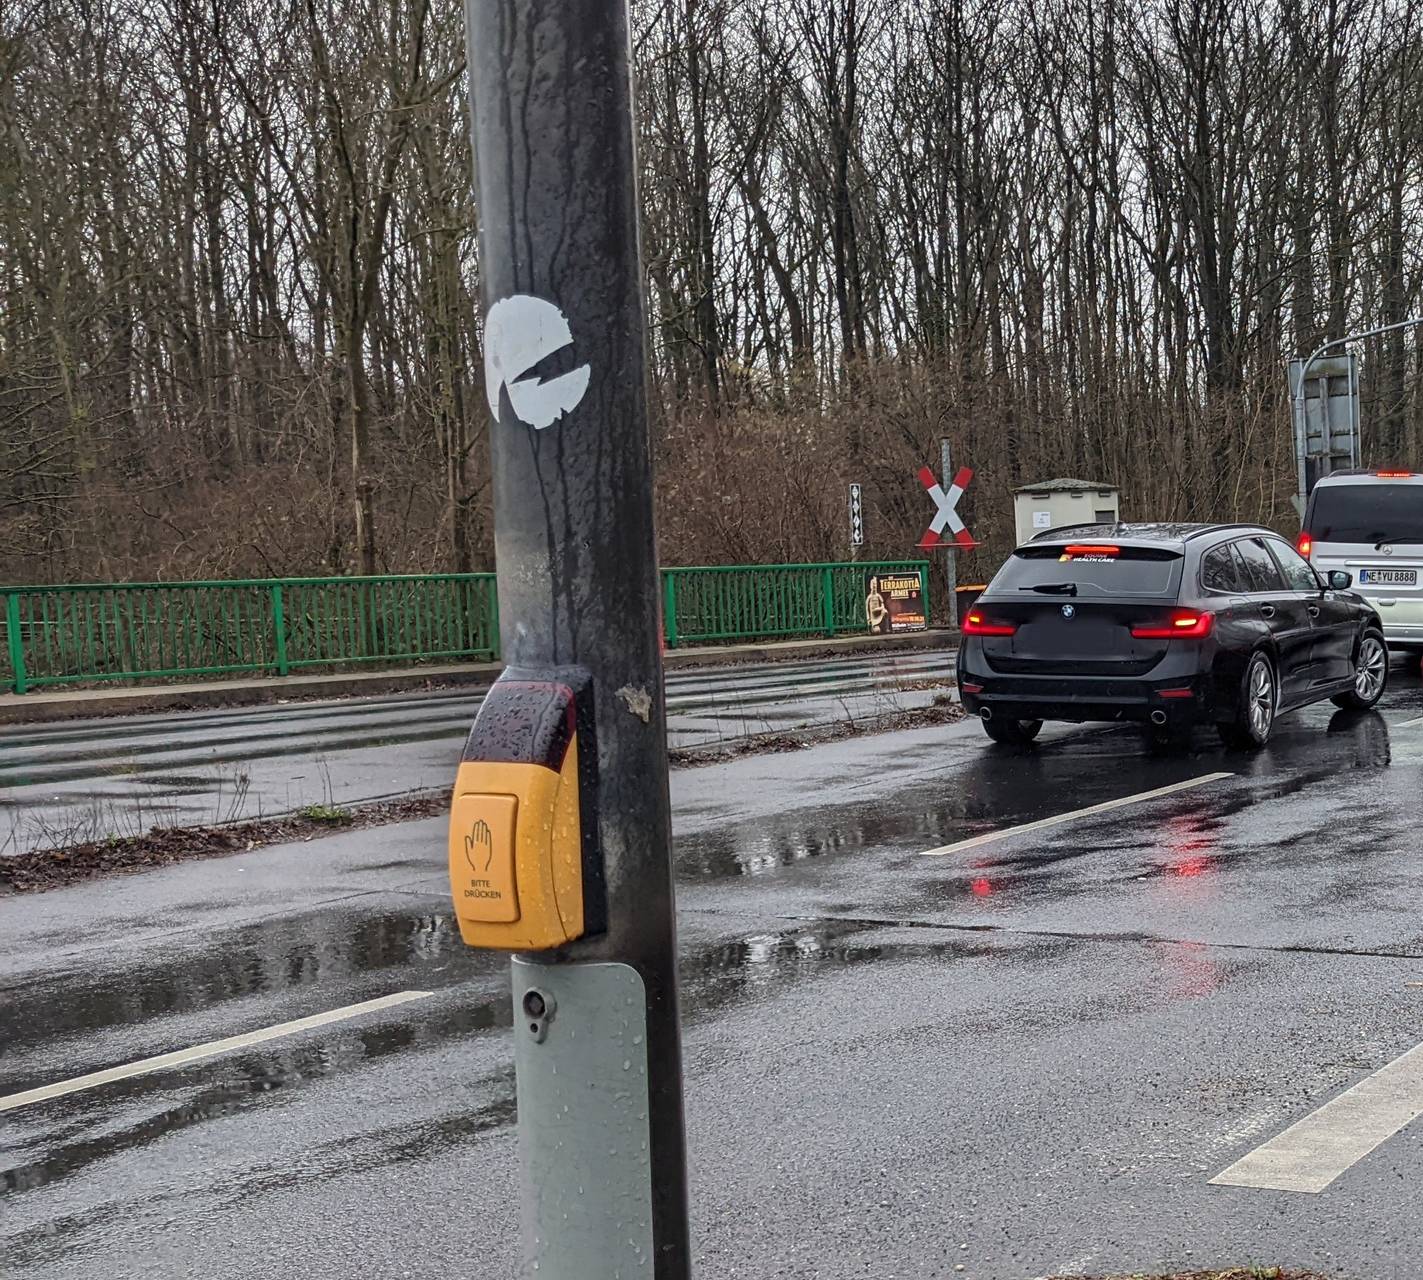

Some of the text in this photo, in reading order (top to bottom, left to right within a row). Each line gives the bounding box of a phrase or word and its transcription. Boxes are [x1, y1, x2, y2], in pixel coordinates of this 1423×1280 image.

[1367, 572, 1415, 582] NE YU 8888
[880, 577, 920, 591] TERRAKOTTA
[471, 880, 491, 888] BITTE
[464, 889, 502, 898] DRÜCKEN
